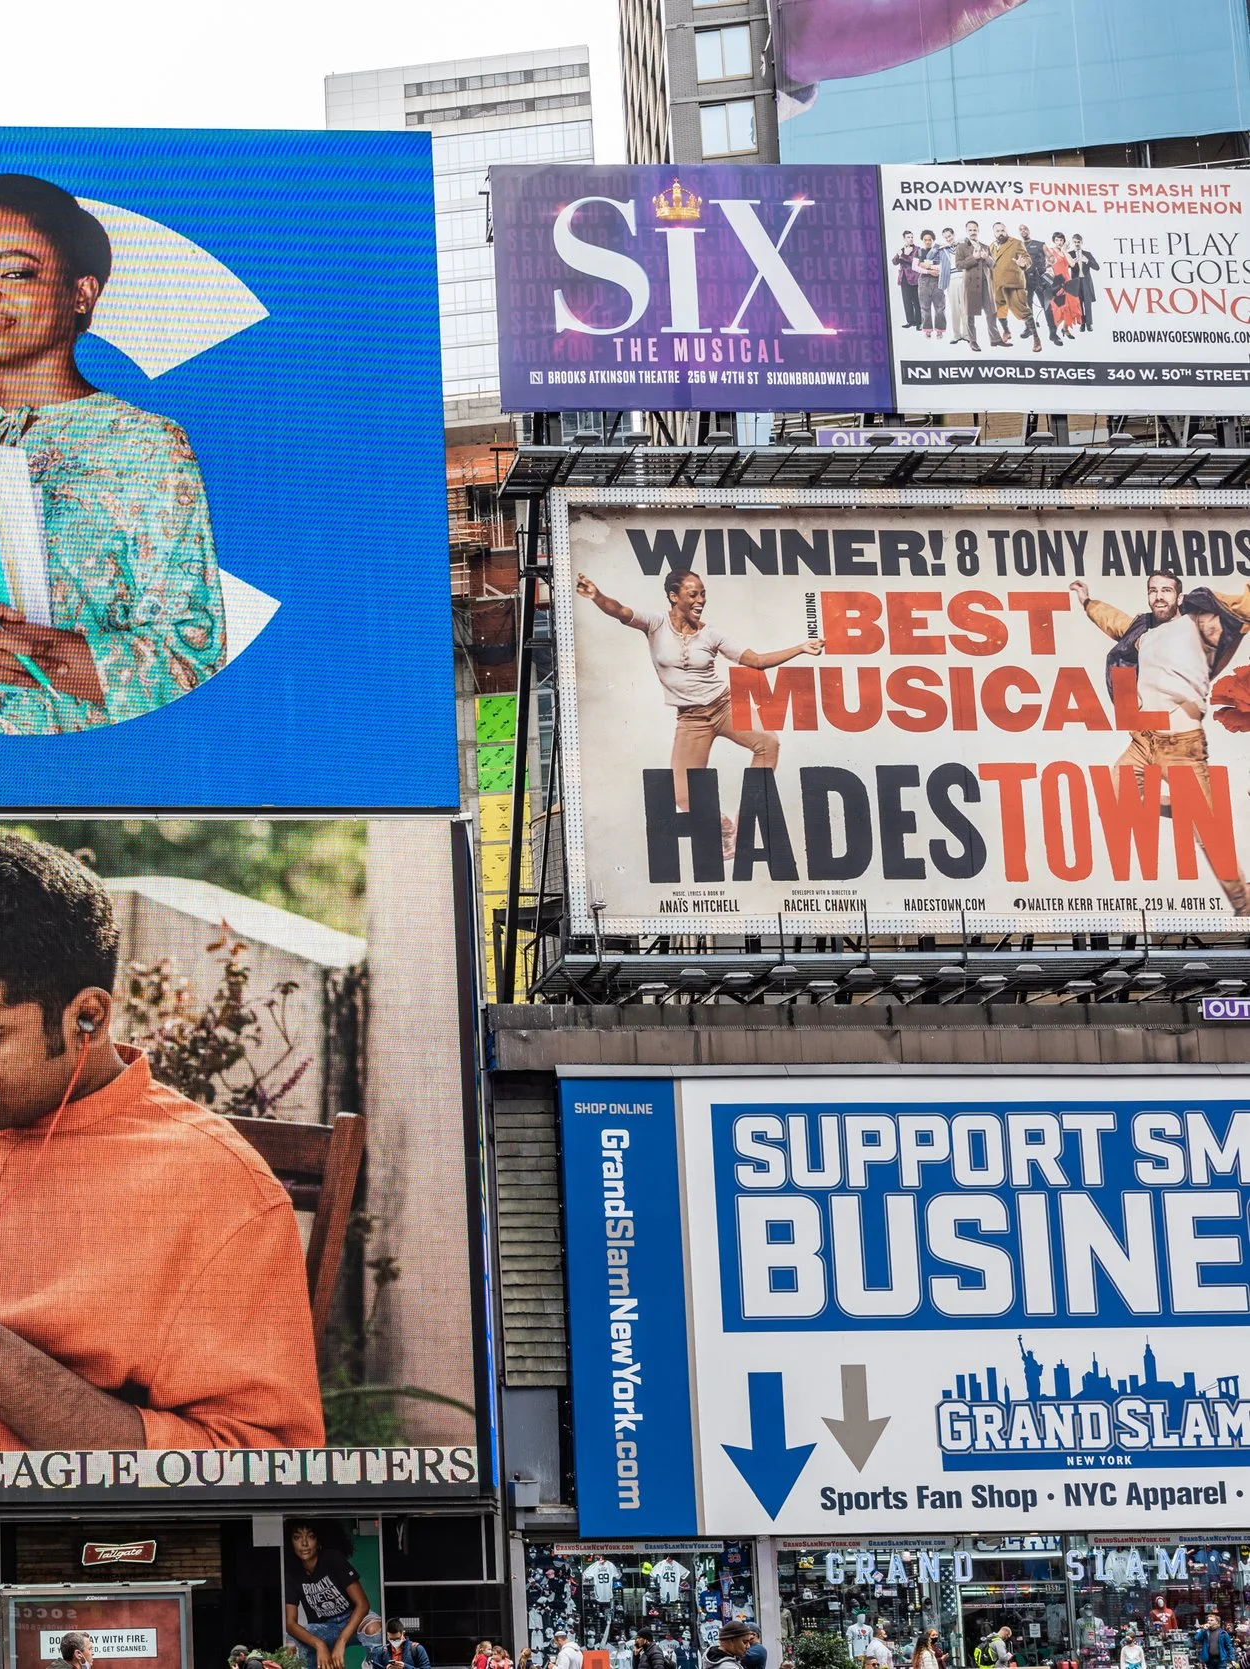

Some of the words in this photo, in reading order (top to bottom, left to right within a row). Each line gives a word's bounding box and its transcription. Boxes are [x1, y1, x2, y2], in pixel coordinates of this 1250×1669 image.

[900, 181, 1024, 195] BROADWAY'S
[1029, 182, 1120, 196] FUNNIEST
[1127, 183, 1194, 197] SMASH
[1201, 184, 1231, 197] HIT
[892, 198, 932, 211] AND
[938, 199, 1097, 213] INTERNATIONAL
[1104, 201, 1242, 214] PHENOMENON
[1113, 237, 1160, 255] THE
[1166, 232, 1240, 256] PLAY
[553, 197, 837, 335] SIX
[1103, 261, 1165, 279] THAT
[613, 338, 658, 362] THE
[674, 338, 784, 363] MUSICAL
[548, 371, 586, 385] BROOKS
[589, 371, 635, 385] ATKINSON
[639, 371, 680, 384] THEATRE
[687, 371, 706, 385] 256
[708, 371, 719, 385] W
[721, 372, 746, 385] 47TH
[748, 372, 759, 385] ST
[767, 372, 870, 385] SIXONBROADWAY.COM
[938, 367, 974, 379] NEW
[979, 367, 1035, 379] WORLD
[1040, 368, 1096, 380] STAGES
[1107, 369, 1135, 380] 340
[1138, 369, 1158, 381] W.
[1162, 369, 1192, 381] 50TH
[1195, 370, 1250, 381] STREET
[625, 529, 946, 577] WINNER!
[955, 529, 980, 577] 8
[988, 530, 1088, 577] TONY
[805, 592, 818, 639] INCLUDING
[820, 590, 1071, 656] BEST
[728, 665, 1170, 733] MUSICAL
[642, 760, 1240, 883] HADESTOWN
[692, 900, 740, 913] MITCHELL
[784, 899, 821, 912] RACHEL
[824, 899, 866, 912] CHAVKIN
[904, 898, 985, 912] HADESTOWN.COM
[1028, 899, 1064, 911] WALTER
[1068, 898, 1093, 911] KERR
[1096, 898, 1144, 912] THEATRE,
[1145, 898, 1163, 911] 219
[1166, 898, 1178, 911] W.
[1180, 898, 1206, 911] 48TH
[1209, 898, 1223, 911] ST.
[574, 1102, 607, 1114] SHOP
[609, 1103, 653, 1115] ONLINE
[733, 1111, 1117, 1190] SUPPORT
[736, 1190, 1250, 1318] BUSINE
[600, 1128, 644, 1510] GrandSlamNewYork.com
[156, 1448, 476, 1487] OUTFITTERS
[1067, 1456, 1094, 1466] NEW
[1099, 1455, 1132, 1465] YORK
[820, 1486, 908, 1515] Sports
[916, 1485, 963, 1509] Fan
[971, 1484, 1037, 1512] Shop
[1063, 1482, 1117, 1507] NYC
[1126, 1481, 1227, 1510] Apparel
[94, 1546, 144, 1560] Tailgate
[706, 1559, 715, 1570] 14
[825, 1550, 974, 1584] GRAND
[1066, 1547, 1189, 1581] SLAM
[598, 1574, 609, 1583] 99
[663, 1572, 675, 1582] 45
[102, 1635, 123, 1644] WITH
[127, 1635, 148, 1643] FIRE.
[707, 1631, 718, 1640] 42
